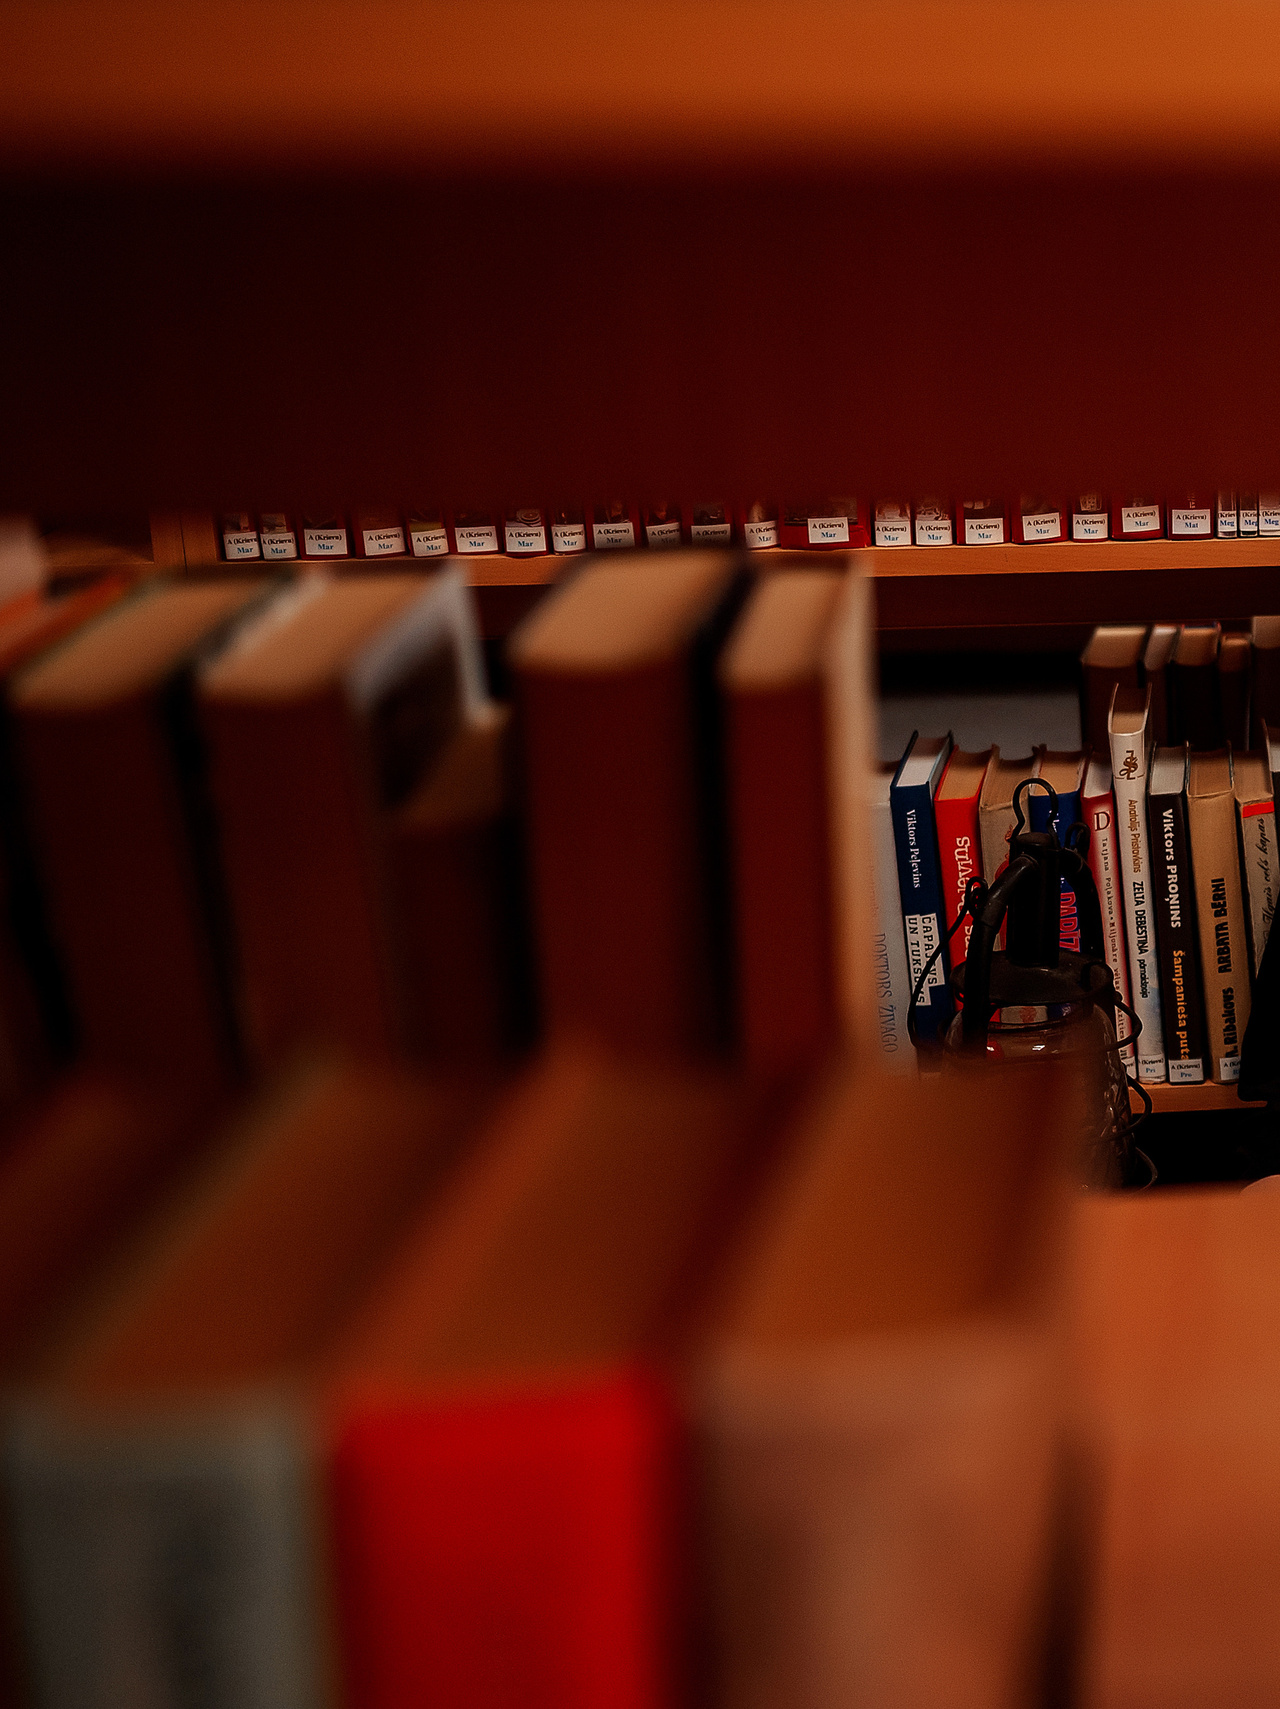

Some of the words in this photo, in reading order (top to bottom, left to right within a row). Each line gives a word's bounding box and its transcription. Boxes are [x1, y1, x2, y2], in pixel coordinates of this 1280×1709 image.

[906, 809, 917, 847] Viktors
[1094, 811, 1111, 832] D
[1128, 799, 1139, 832] Anatolijs
[1163, 808, 1175, 861] Viktors
[909, 848, 922, 888] Peļevins
[1100, 838, 1110, 872] Tatjana
[1133, 881, 1145, 907] ZELTA
[1165, 864, 1182, 929] PROŅINS
[1211, 877, 1228, 918] BĒRNI
[908, 917, 918, 935] UN
[1135, 909, 1149, 955] DEBESTIŅA
[874, 933, 893, 998] DOKTORS
[922, 916, 937, 985] ČAPAJVS
[1215, 922, 1232, 974] ARBATA
[1172, 950, 1188, 1027] Šampanieša
[1222, 987, 1238, 1046] Ribakovs
